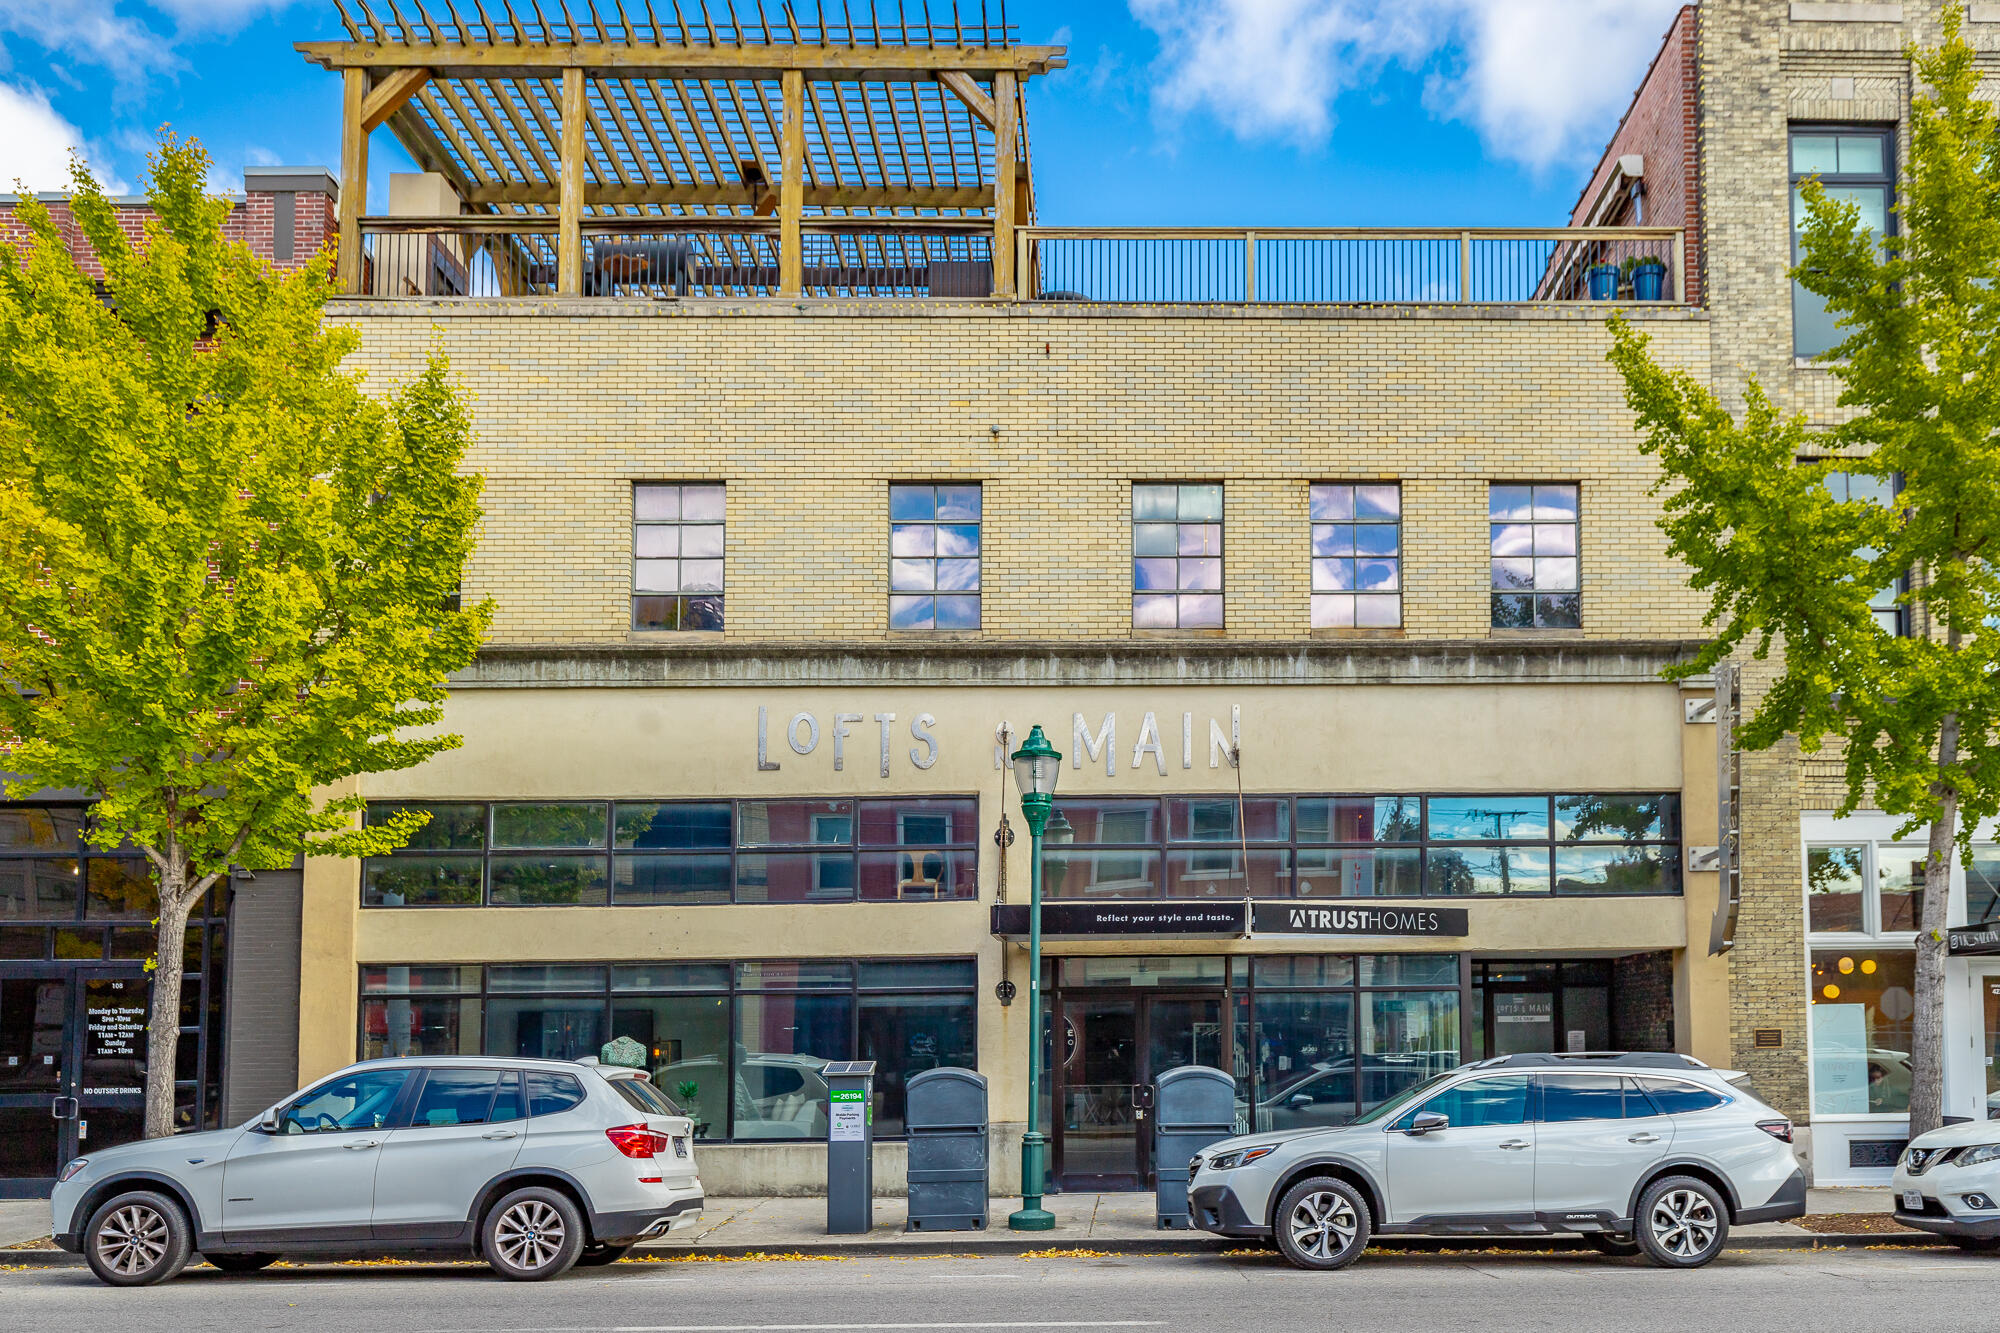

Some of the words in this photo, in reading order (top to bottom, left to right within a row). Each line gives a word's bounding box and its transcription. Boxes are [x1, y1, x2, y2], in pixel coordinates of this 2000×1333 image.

[758, 705, 939, 778] LOFTS
[1072, 703, 1240, 777] MAIN
[1096, 914, 1128, 922] Reflect
[1158, 914, 1182, 923] style
[119, 1007, 144, 1015] Thursday
[93, 1087, 118, 1095] OUTSIDE
